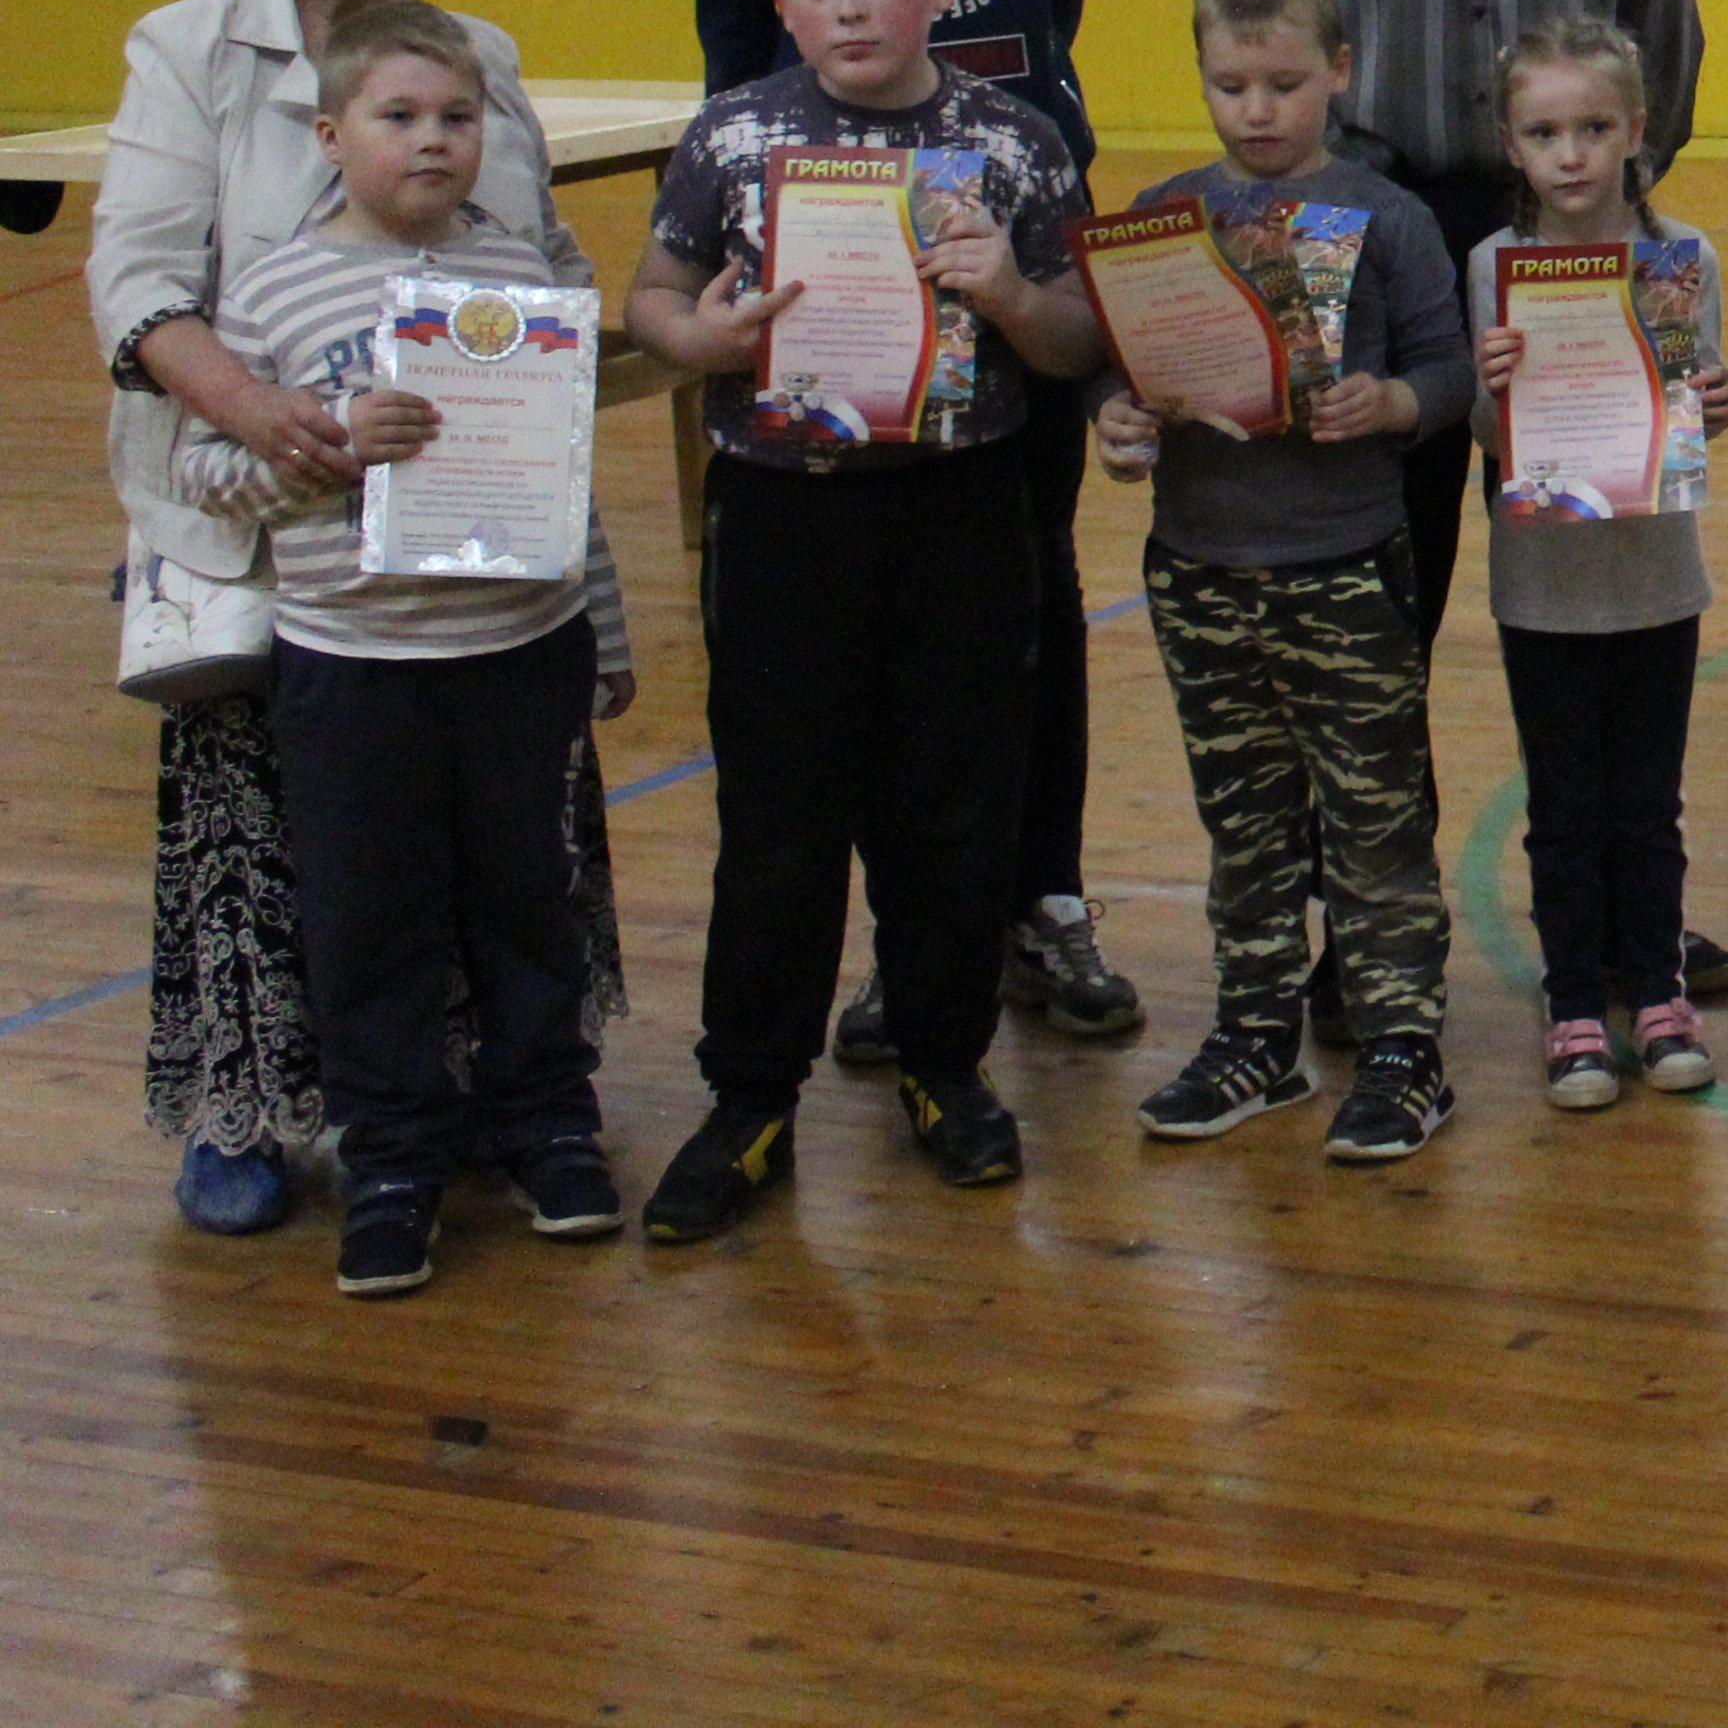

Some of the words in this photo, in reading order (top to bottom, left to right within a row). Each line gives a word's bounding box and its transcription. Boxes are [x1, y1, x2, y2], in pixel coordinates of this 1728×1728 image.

[785, 159, 898, 179] ГРАМОТА
[1083, 211, 1194, 245] ГРАМОТА
[1511, 256, 1619, 277] ГРАМОТА
